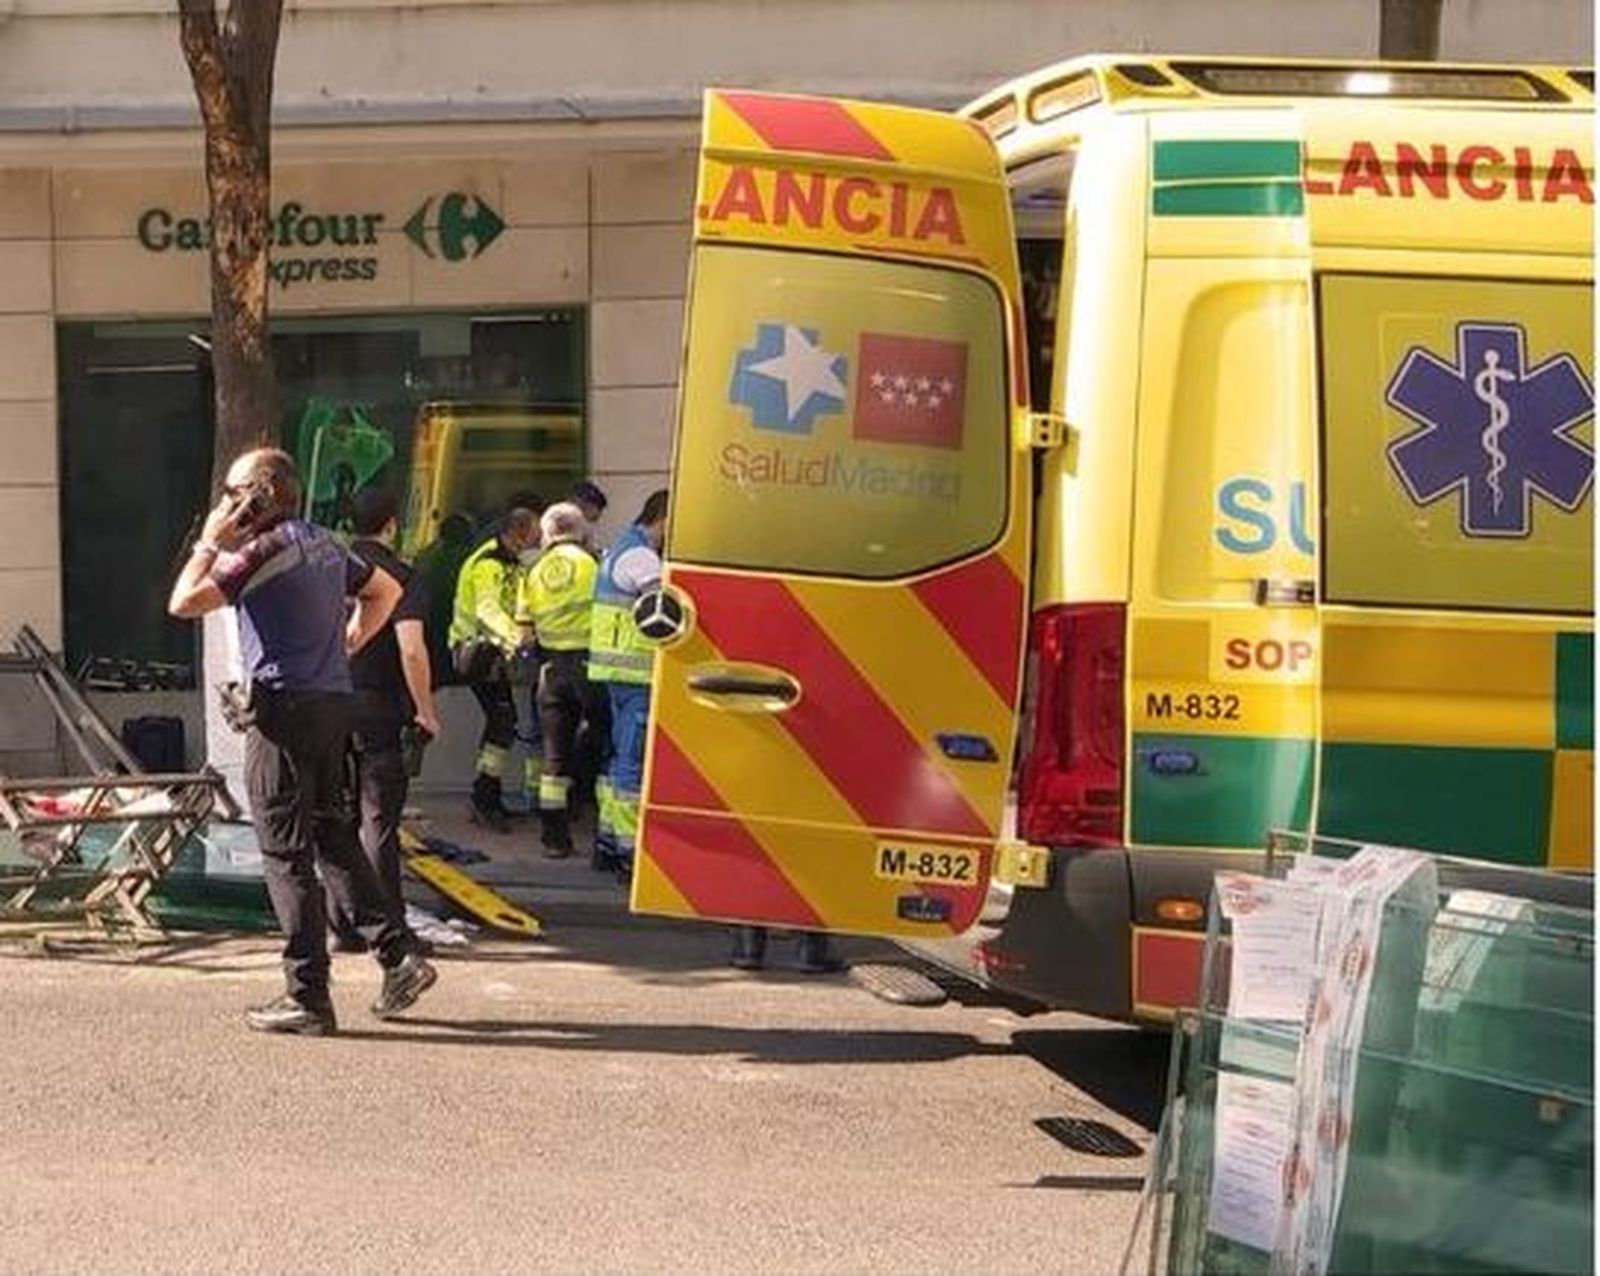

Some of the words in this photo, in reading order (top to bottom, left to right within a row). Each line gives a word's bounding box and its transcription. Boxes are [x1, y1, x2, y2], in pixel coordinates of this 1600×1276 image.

[138, 202, 384, 251] Cafour
[267, 256, 377, 288] xpress
[1225, 638, 1312, 671] SOP
[1146, 693, 1241, 720] M-832
[880, 849, 971, 881] M-832
